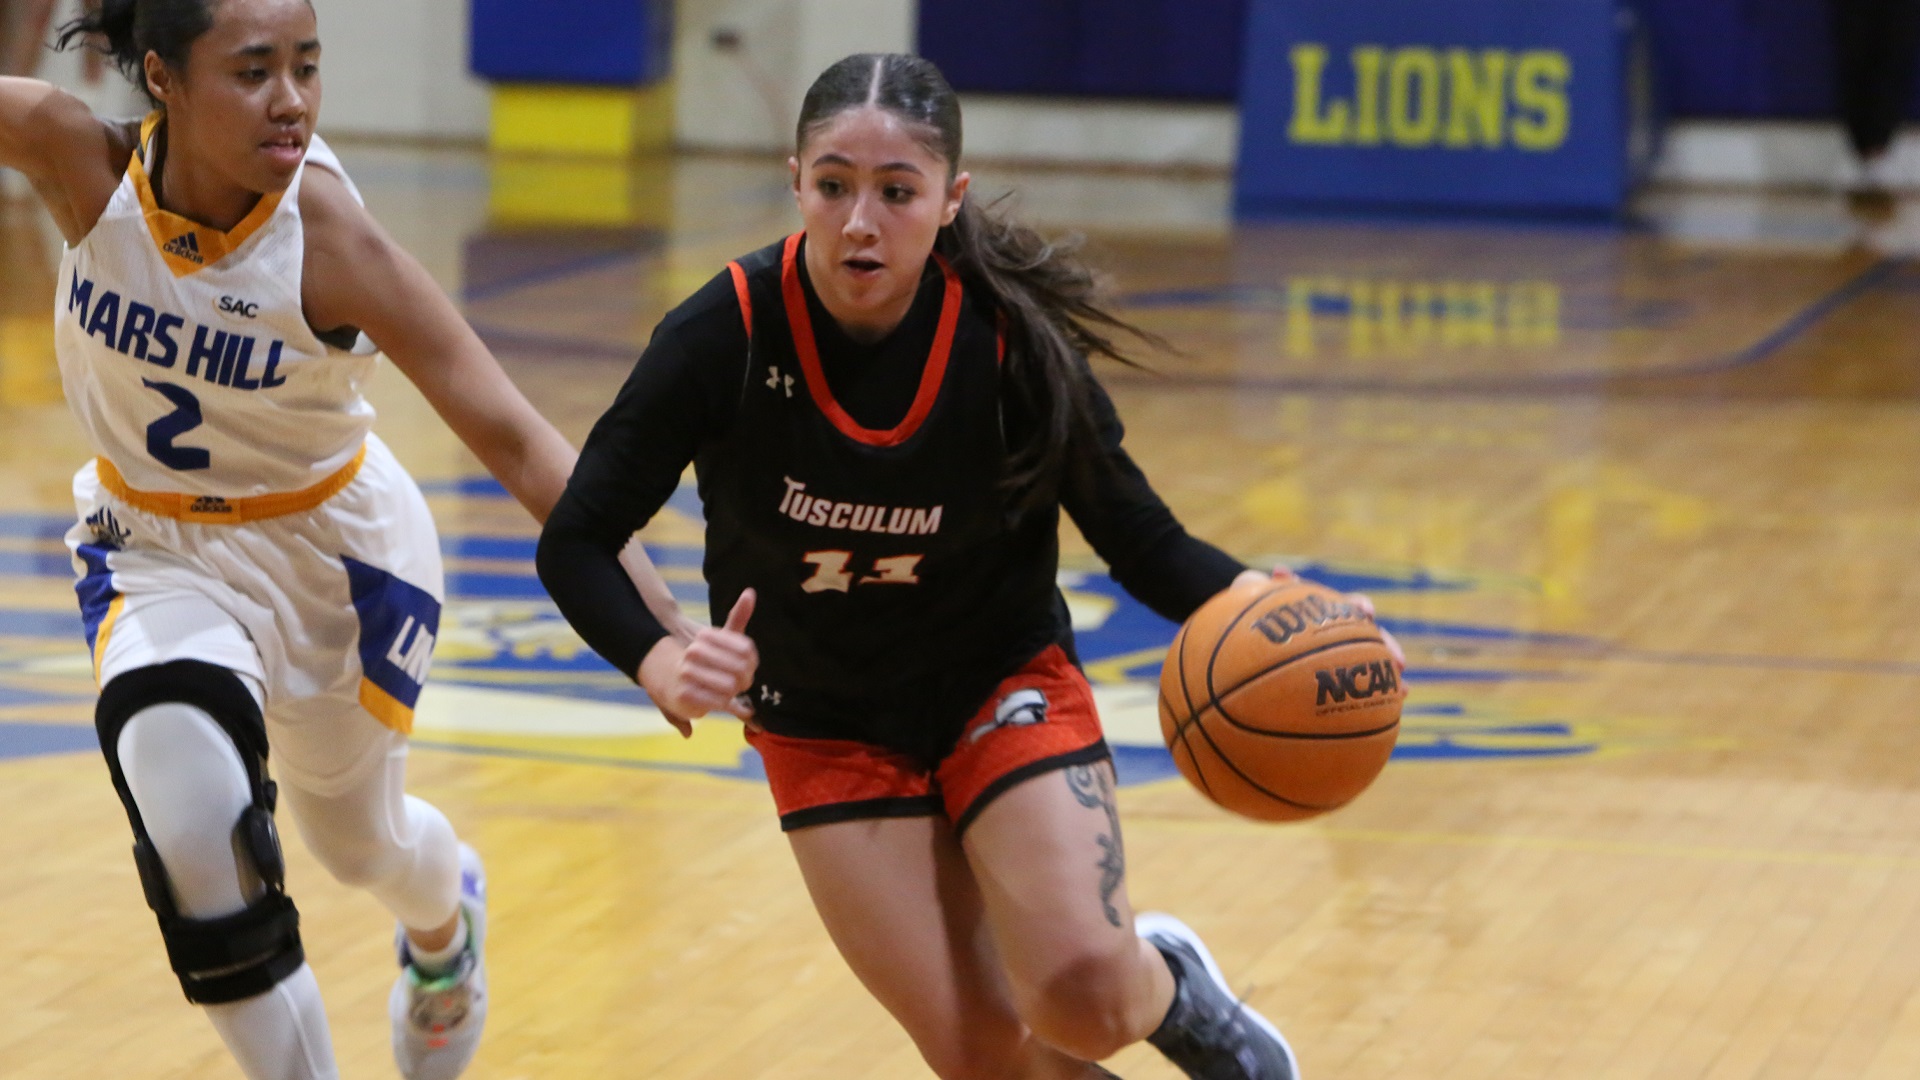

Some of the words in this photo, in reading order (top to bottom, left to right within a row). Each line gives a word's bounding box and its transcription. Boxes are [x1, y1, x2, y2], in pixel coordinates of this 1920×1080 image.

[1289, 44, 1572, 151] LIONS
[163, 242, 204, 264] adidas
[69, 266, 184, 369] MARS
[186, 325, 287, 390] HILL
[219, 295, 259, 319] SAC
[142, 377, 210, 471] 2
[190, 503, 232, 514] adidas
[779, 475, 943, 534] TUSCULUM
[1315, 659, 1398, 706] NCAA
